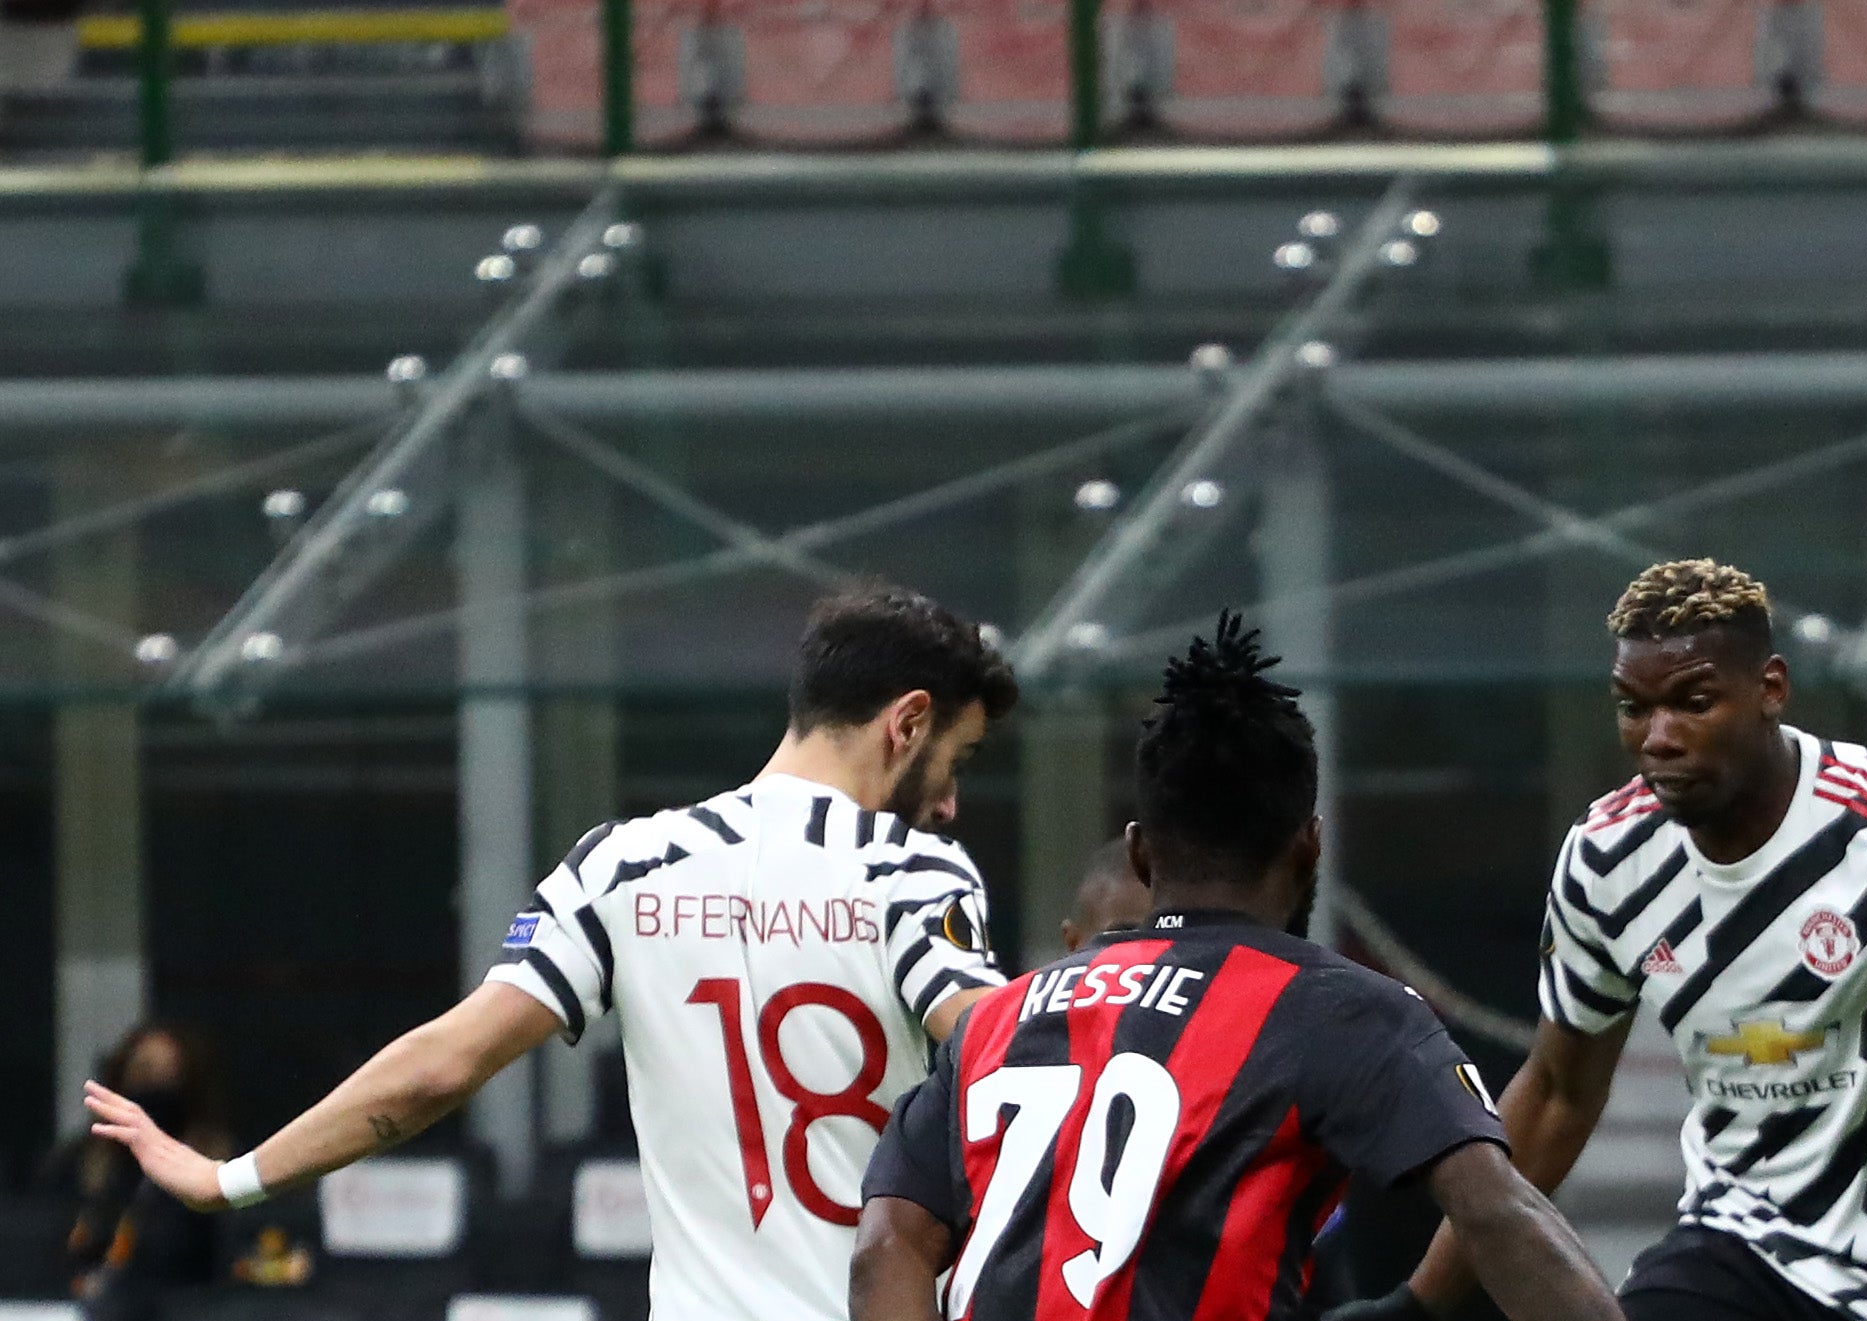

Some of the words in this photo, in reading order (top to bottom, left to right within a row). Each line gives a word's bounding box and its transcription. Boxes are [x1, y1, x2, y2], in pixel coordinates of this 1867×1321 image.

[635, 893, 879, 948] B.FERNANDES
[1154, 915, 1184, 929] ACM
[1018, 963, 1205, 1023] KESSIE
[685, 978, 892, 1233] 18
[1706, 1070, 1857, 1101] CHEVROLET
[946, 1051, 1181, 1321] 79
